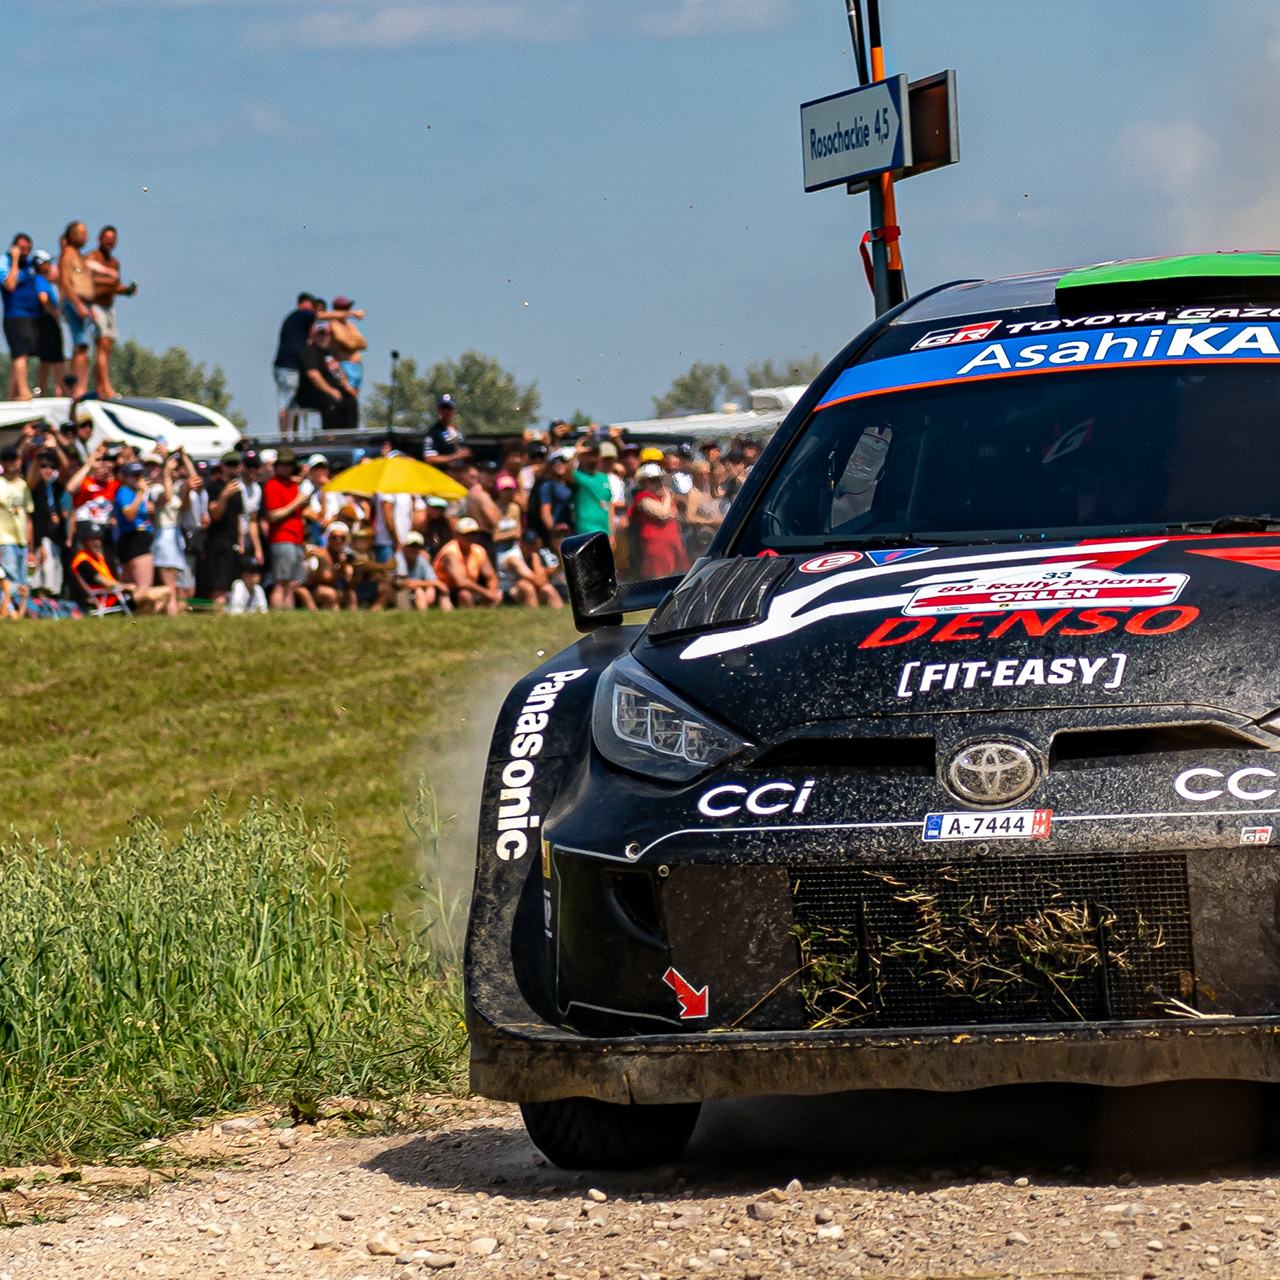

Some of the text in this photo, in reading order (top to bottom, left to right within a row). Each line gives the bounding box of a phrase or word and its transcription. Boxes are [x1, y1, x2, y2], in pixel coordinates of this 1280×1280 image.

[810, 107, 890, 160] Rosochackie 4,5
[913, 322, 1000, 350] GR
[1004, 310, 1167, 334] TOYOTA
[985, 580, 1060, 592] Rally
[1063, 576, 1168, 587] Poland
[1042, 571, 1073, 580] 33
[989, 589, 1100, 602] ORLEN
[858, 605, 1199, 650] DENSO
[897, 653, 1127, 697] [FIT-EASY]
[495, 667, 589, 862] Panasonic
[948, 816, 1025, 836] A-7444
[1033, 824, 1046, 835] 24
[1241, 829, 1271, 844] GR
